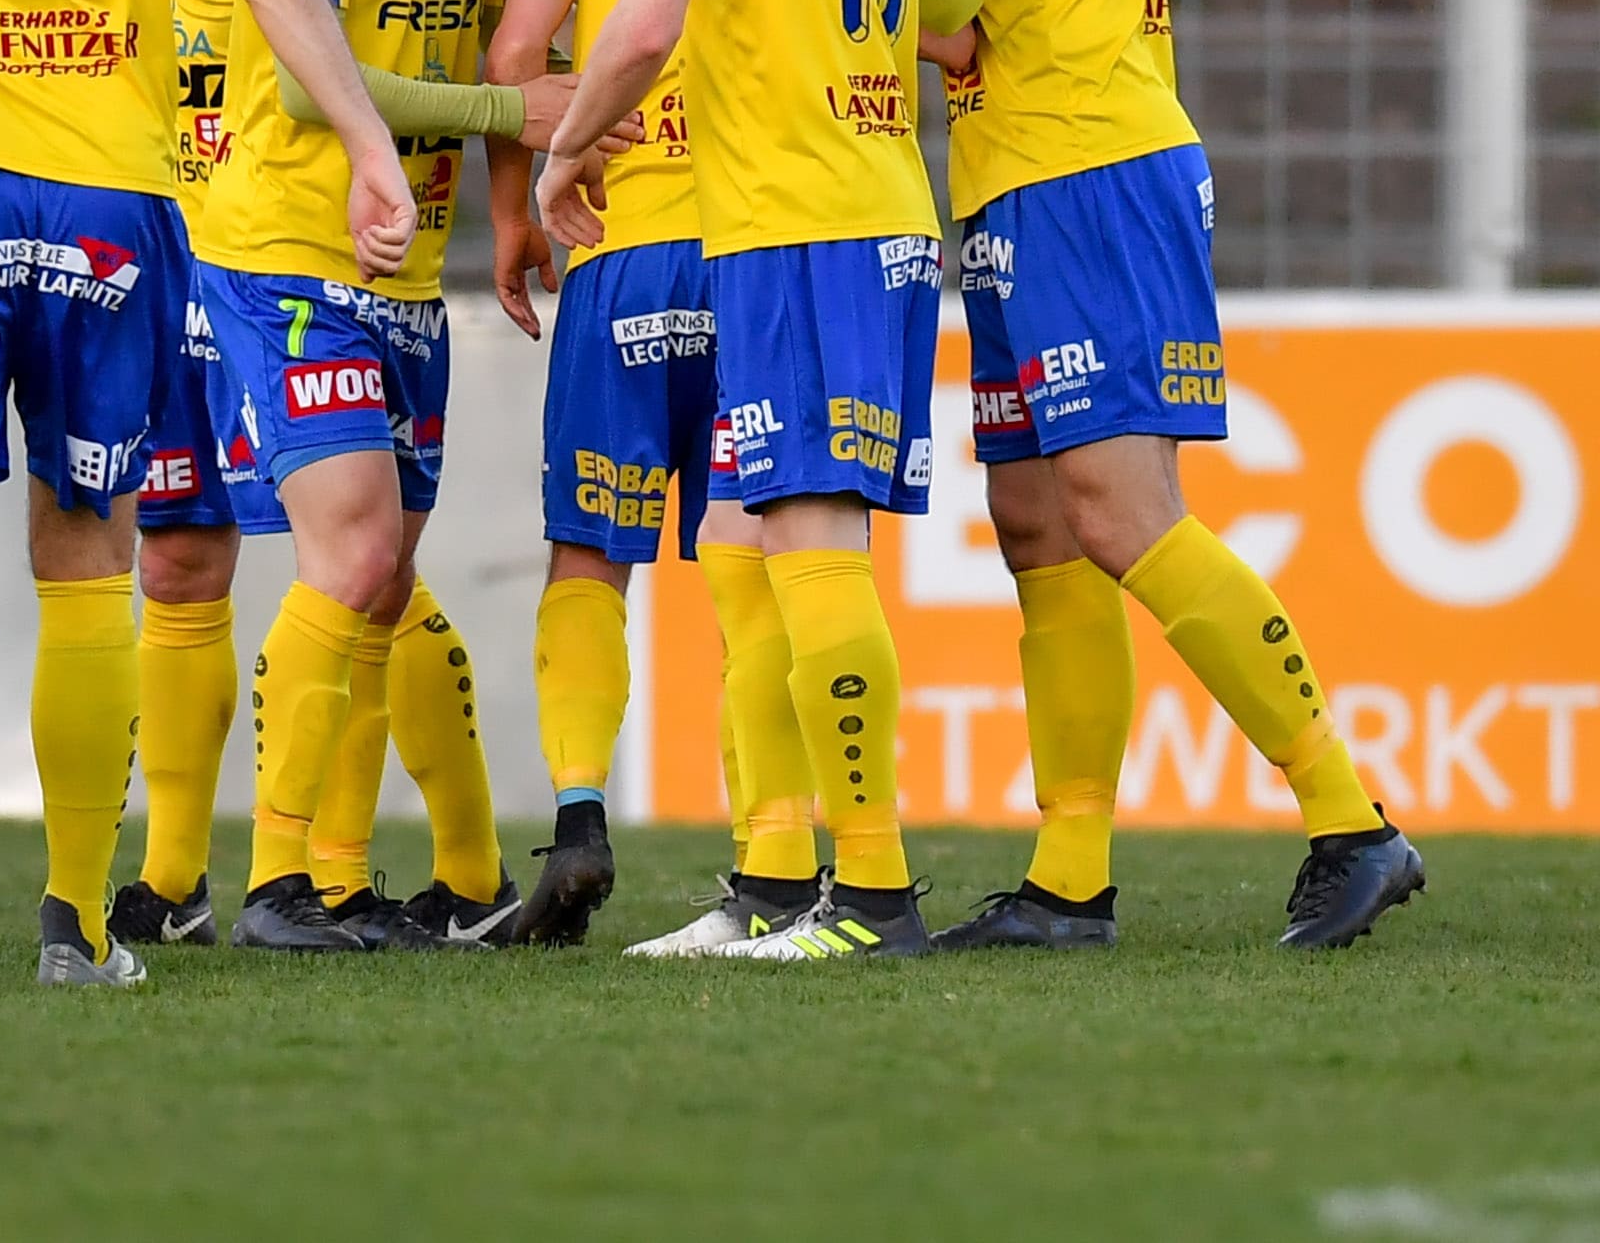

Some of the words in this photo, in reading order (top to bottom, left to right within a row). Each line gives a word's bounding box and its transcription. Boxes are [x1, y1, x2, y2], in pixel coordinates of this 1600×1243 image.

[278, 298, 313, 358] 7
[290, 367, 386, 409] WOC
[1058, 397, 1092, 416] JAKO
